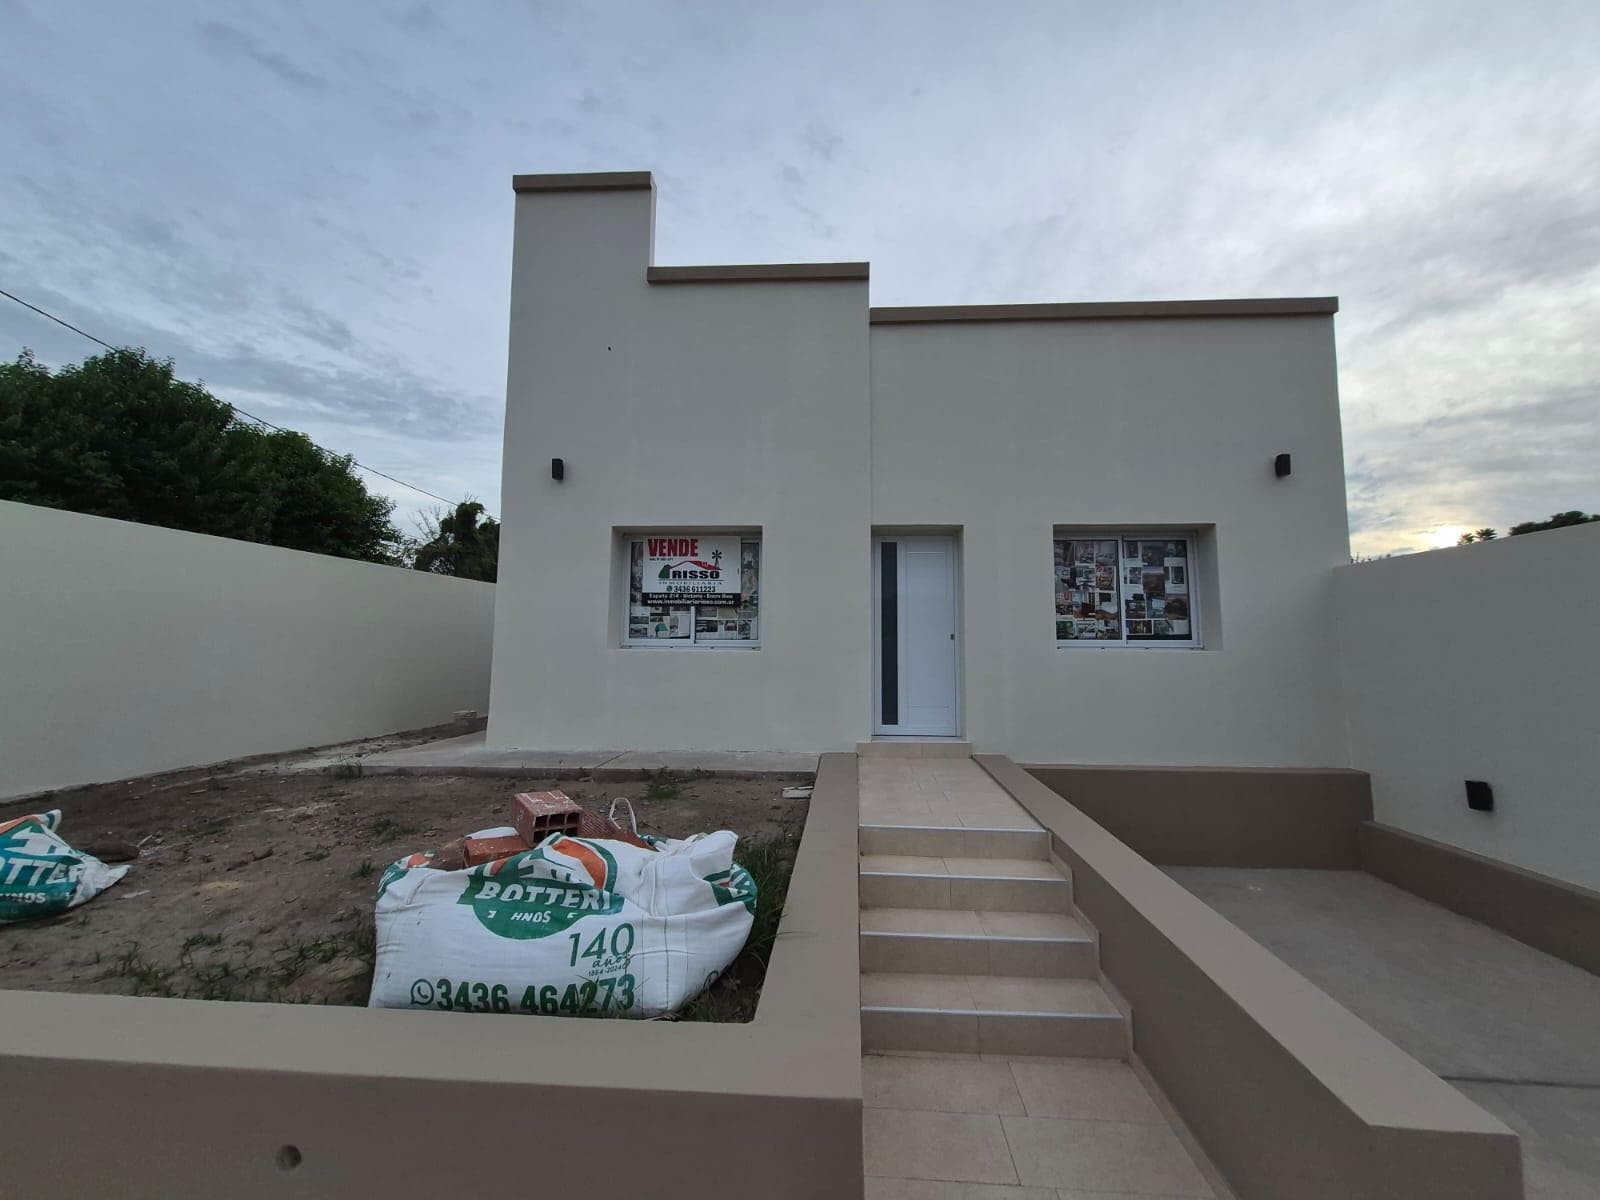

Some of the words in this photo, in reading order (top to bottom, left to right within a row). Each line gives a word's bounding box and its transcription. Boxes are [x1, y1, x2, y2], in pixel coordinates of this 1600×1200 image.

[648, 539, 698, 556] VENDE
[672, 570, 720, 579] RISSO
[510, 910, 552, 924] HNOS
[569, 922, 635, 967] 140
[436, 978, 511, 1013] 3436
[519, 973, 636, 1015] 464273
